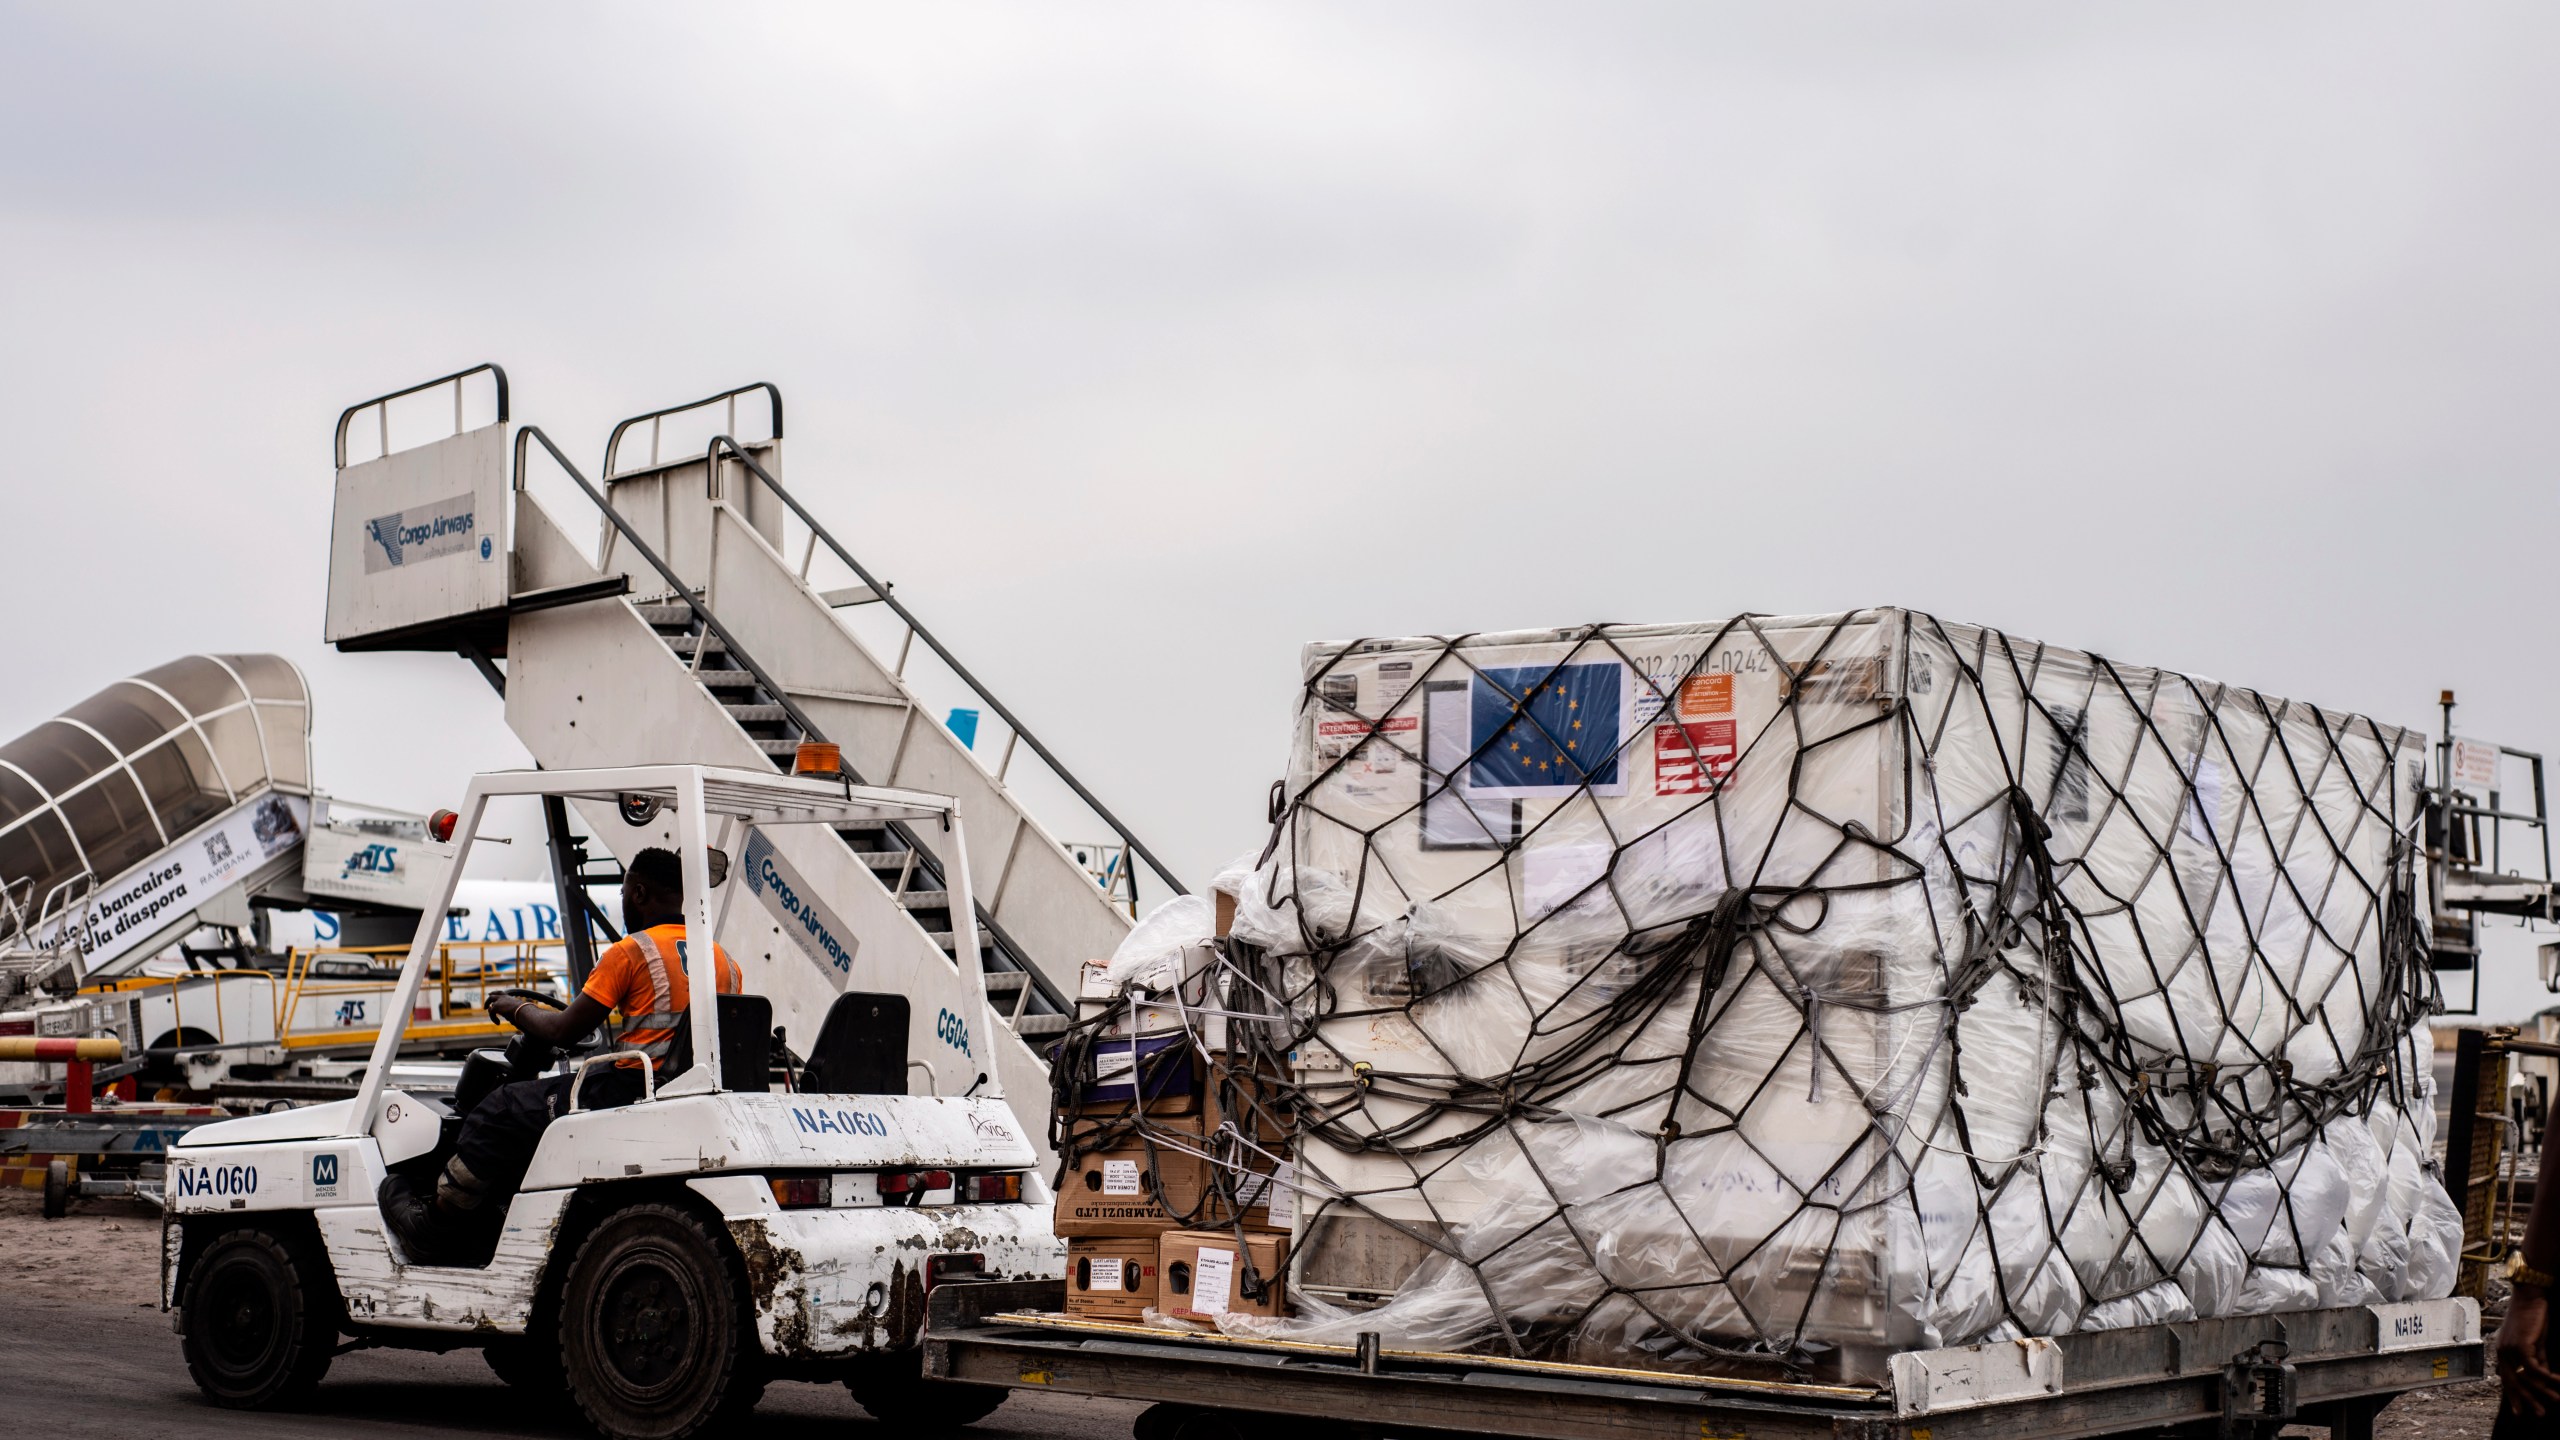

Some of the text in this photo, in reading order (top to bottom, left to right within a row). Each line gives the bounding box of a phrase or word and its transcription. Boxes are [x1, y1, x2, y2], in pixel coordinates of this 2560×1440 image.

[398, 512, 474, 546] Congo Airways
[200, 850, 252, 886] RAWBANK
[100, 862, 183, 920] bancaires
[95, 929, 113, 948] la
[115, 882, 188, 936] diaspora
[761, 858, 852, 973] Congo Airways
[937, 1007, 972, 1059] CG04
[791, 1107, 888, 1137] NA060
[177, 1166, 257, 1196] NA060
[1075, 1207, 1163, 1217] TAMBUZI LTD
[1142, 1266, 1156, 1276] XFL
[1172, 1307, 1189, 1315] KEEP
[2395, 1315, 2423, 1337] NA156
